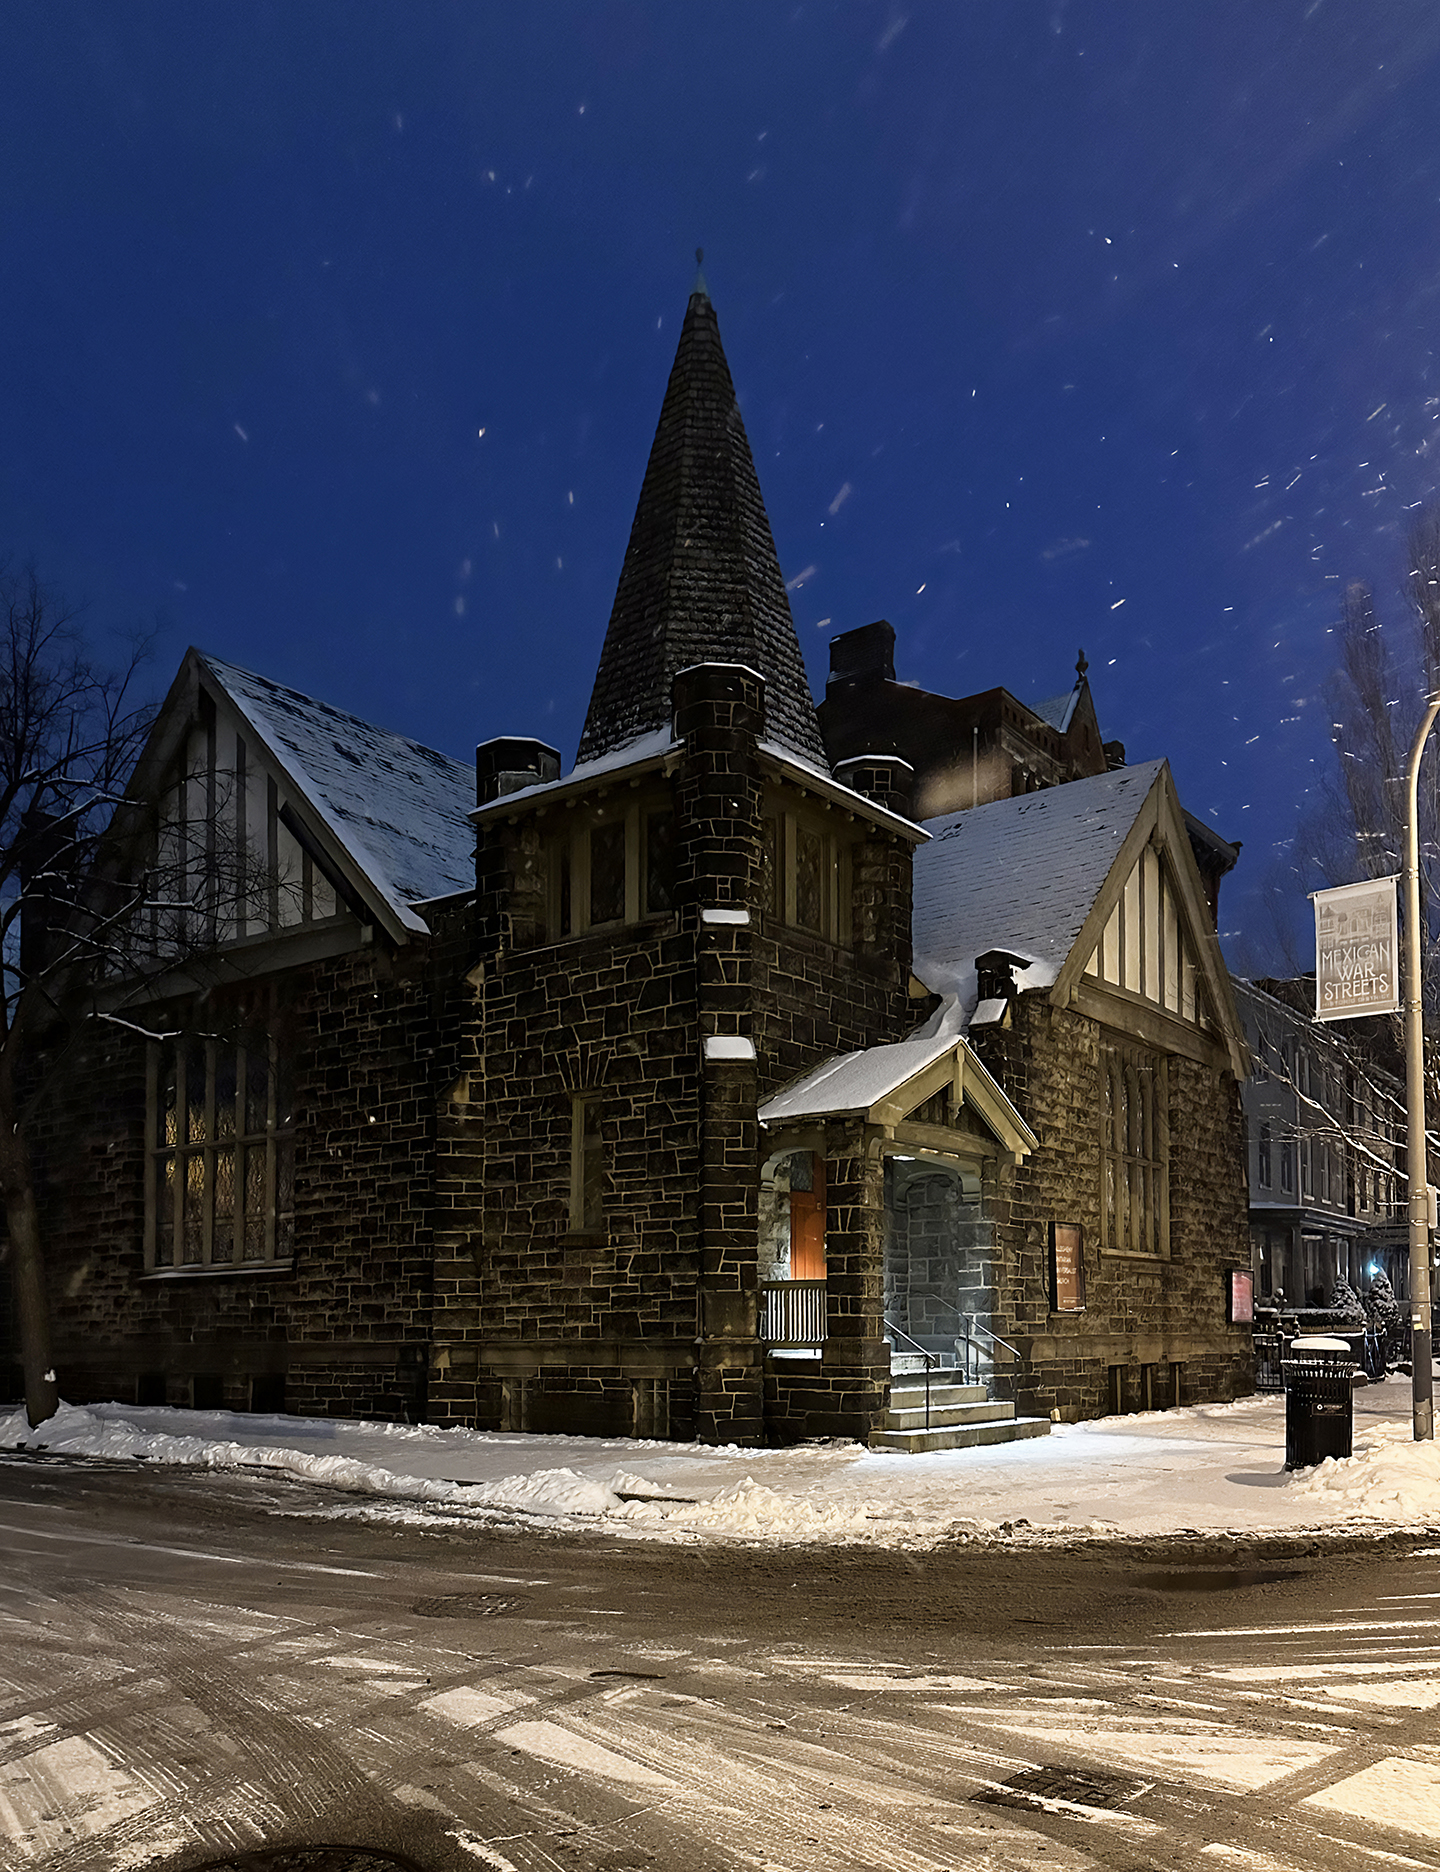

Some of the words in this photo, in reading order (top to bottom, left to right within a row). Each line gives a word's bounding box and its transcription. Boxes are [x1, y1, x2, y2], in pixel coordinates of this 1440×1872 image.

[1322, 941, 1390, 968] MEXICAN
[1337, 962, 1376, 981] WAR
[1324, 973, 1390, 1001] STREETS
